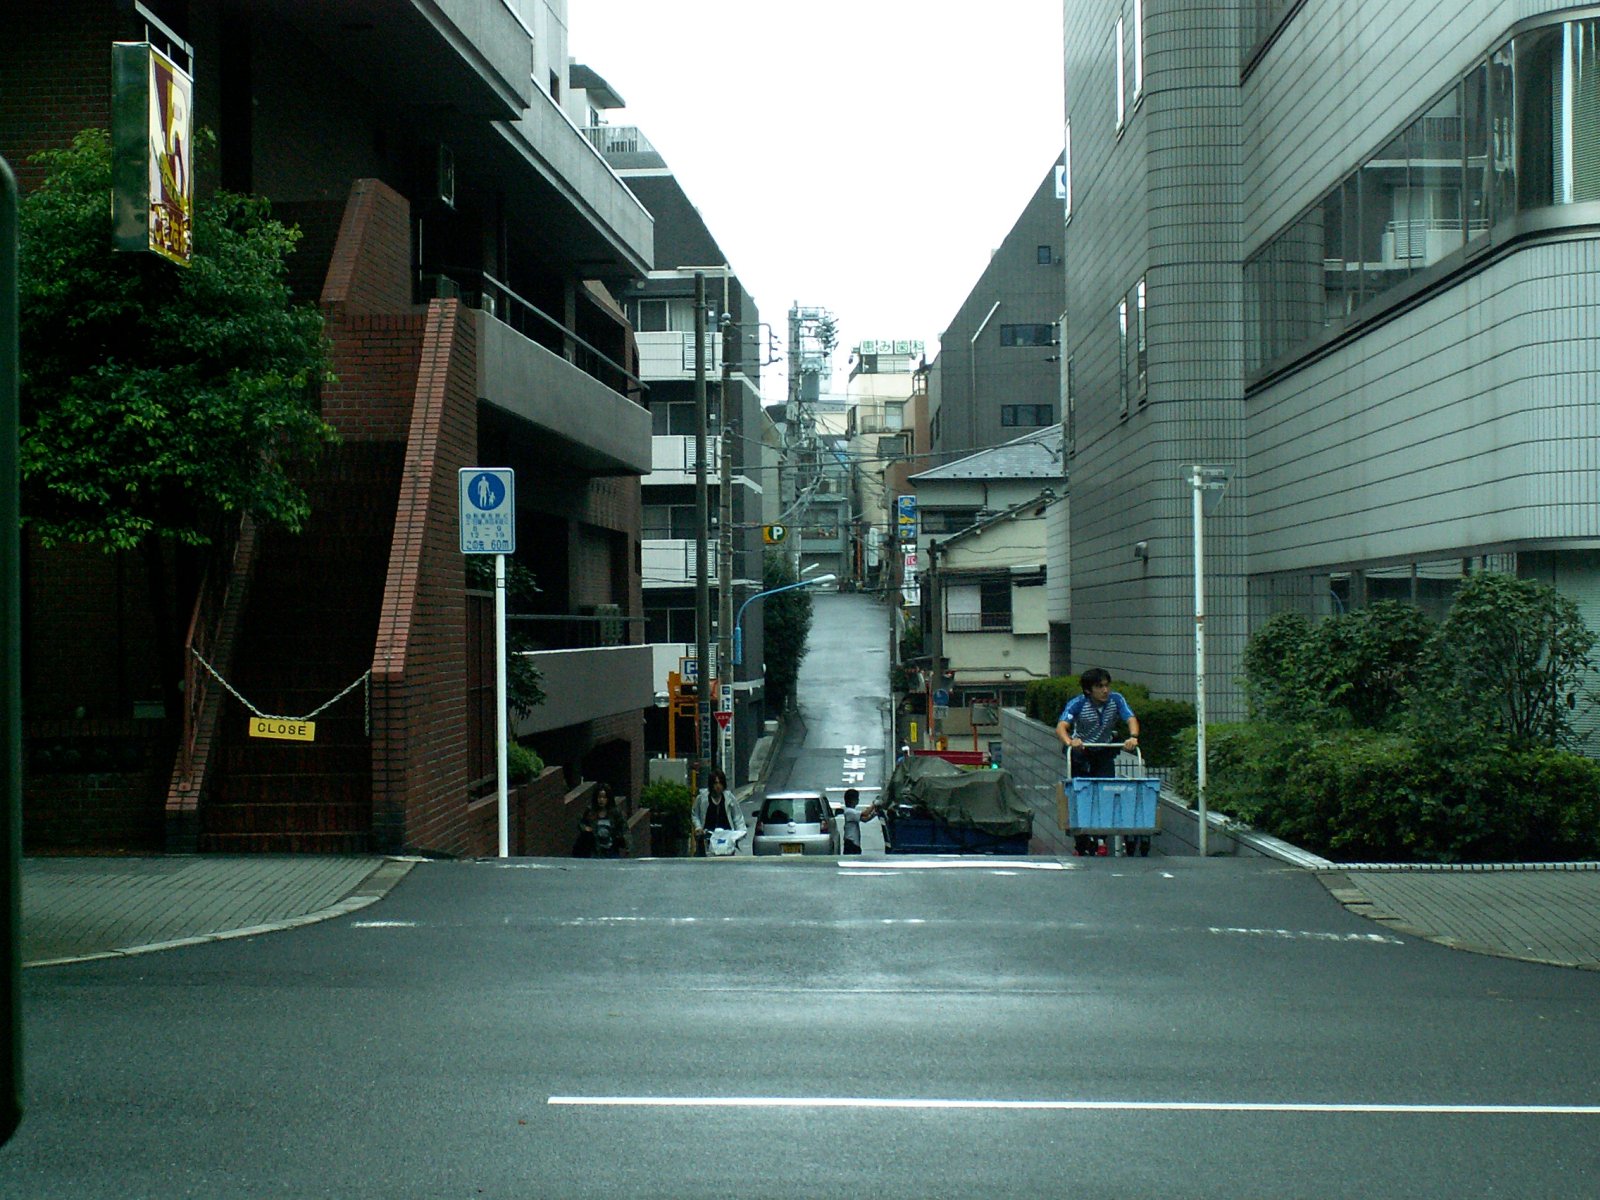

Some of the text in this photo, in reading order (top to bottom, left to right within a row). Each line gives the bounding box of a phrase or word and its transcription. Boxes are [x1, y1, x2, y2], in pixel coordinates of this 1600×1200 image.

[773, 526, 783, 540] P
[491, 539, 509, 550] 60m
[257, 722, 307, 736] CLOSE
